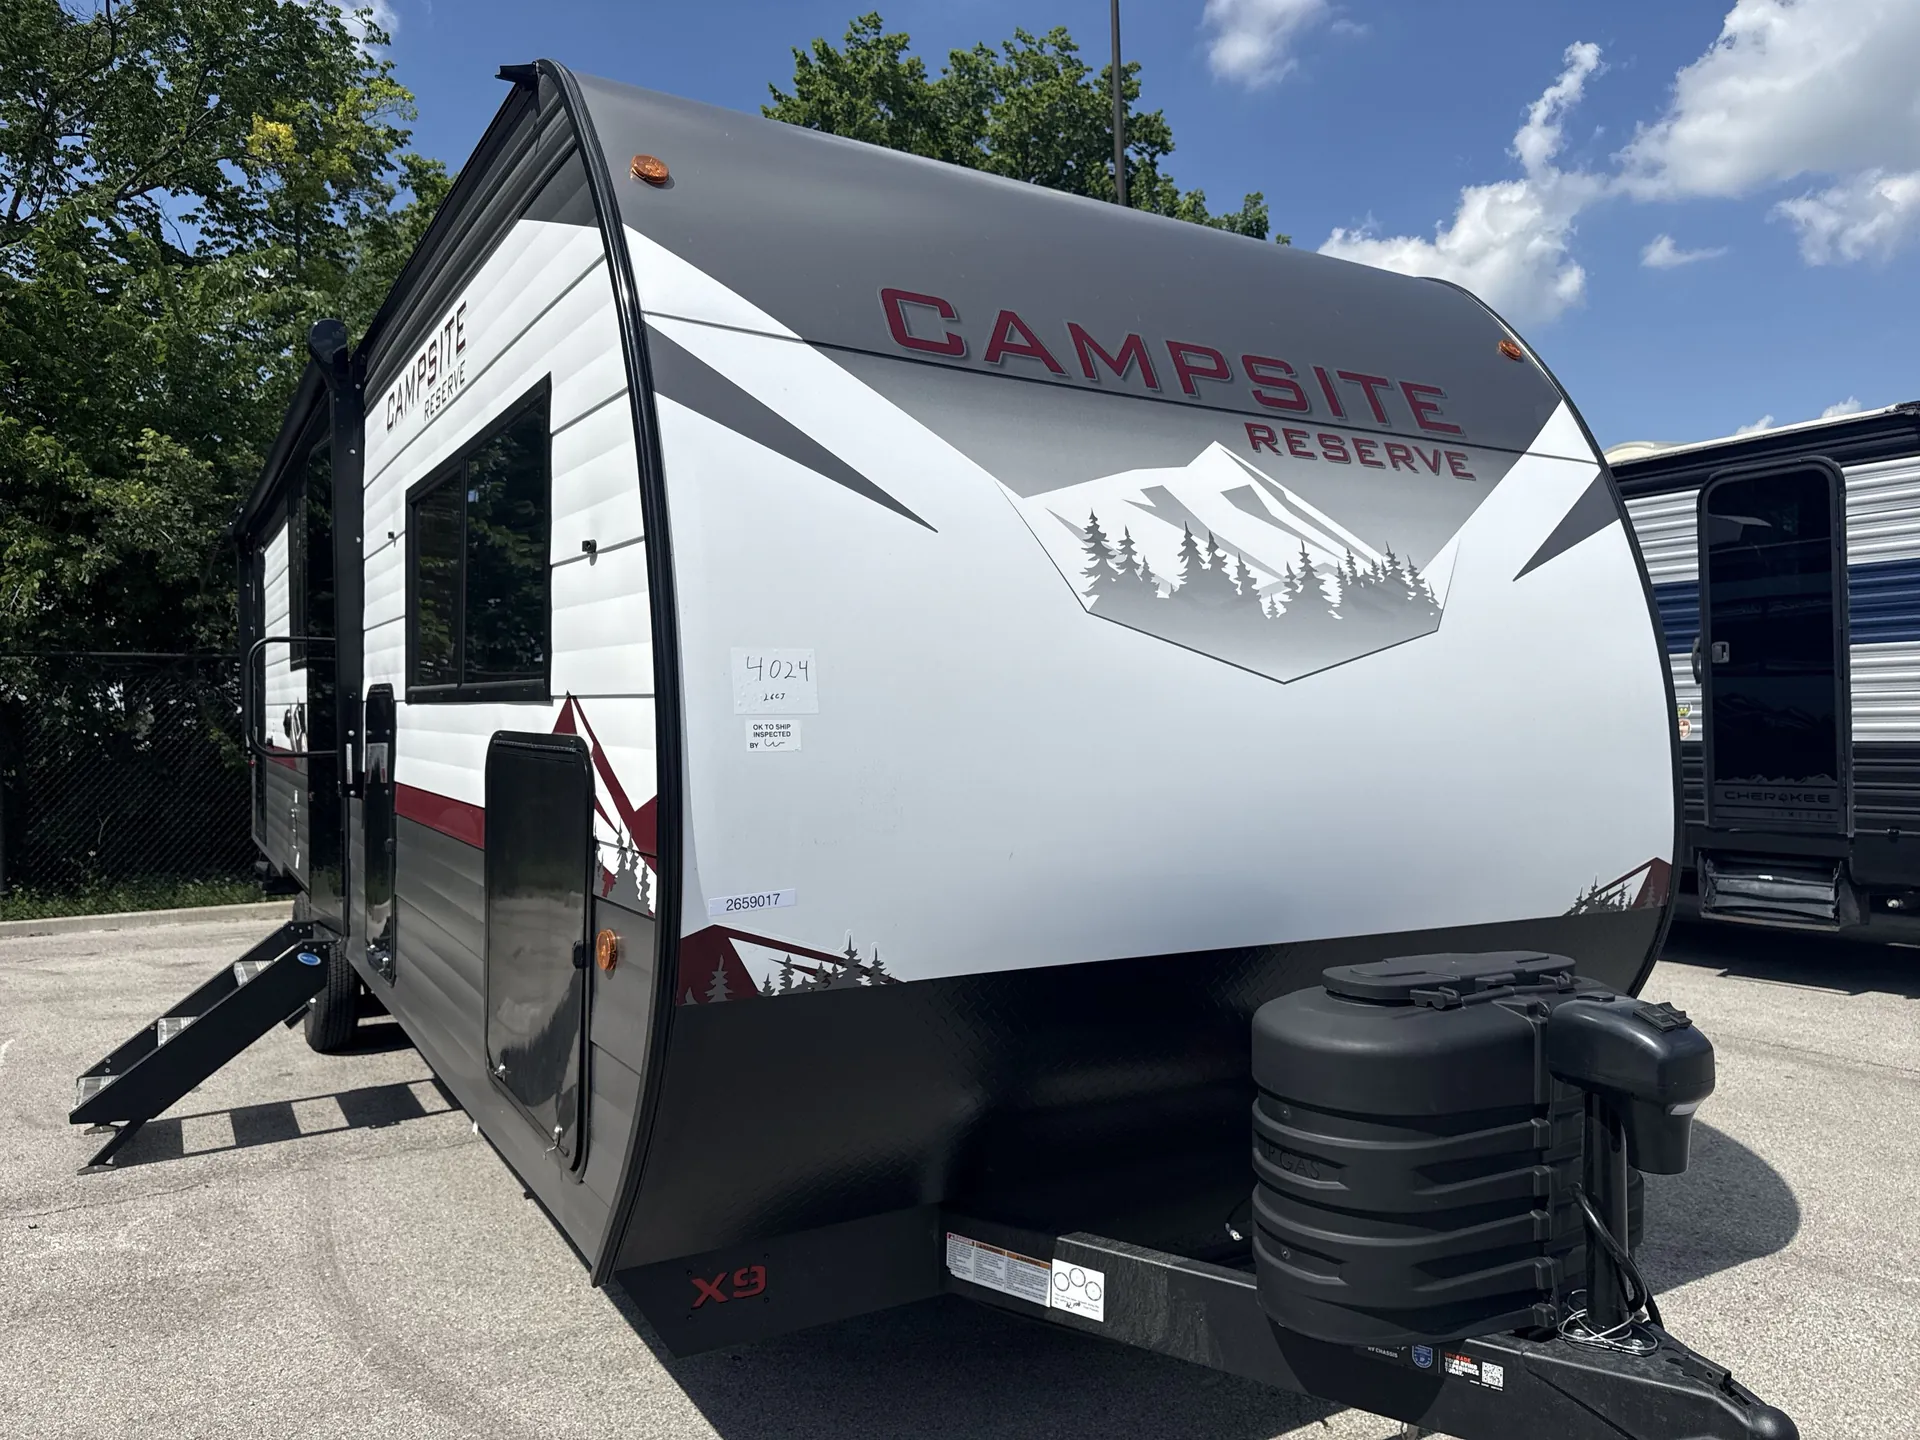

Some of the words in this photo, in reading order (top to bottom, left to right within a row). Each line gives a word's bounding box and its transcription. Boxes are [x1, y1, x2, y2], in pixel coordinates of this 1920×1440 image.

[387, 300, 467, 433] CAMPSITE
[879, 287, 1466, 437] CAMPSITE
[424, 359, 465, 421] RESERVE
[1243, 422, 1477, 481] RESERVE
[745, 655, 809, 682] 4024
[752, 723, 764, 731] OK
[764, 723, 775, 731] TO
[775, 723, 792, 731] SHIP
[725, 893, 781, 912] 2659017
[1280, 1151, 1320, 1180] GAS
[690, 1265, 767, 1310] X9
[1376, 1347, 1399, 1358] CHASSIS
